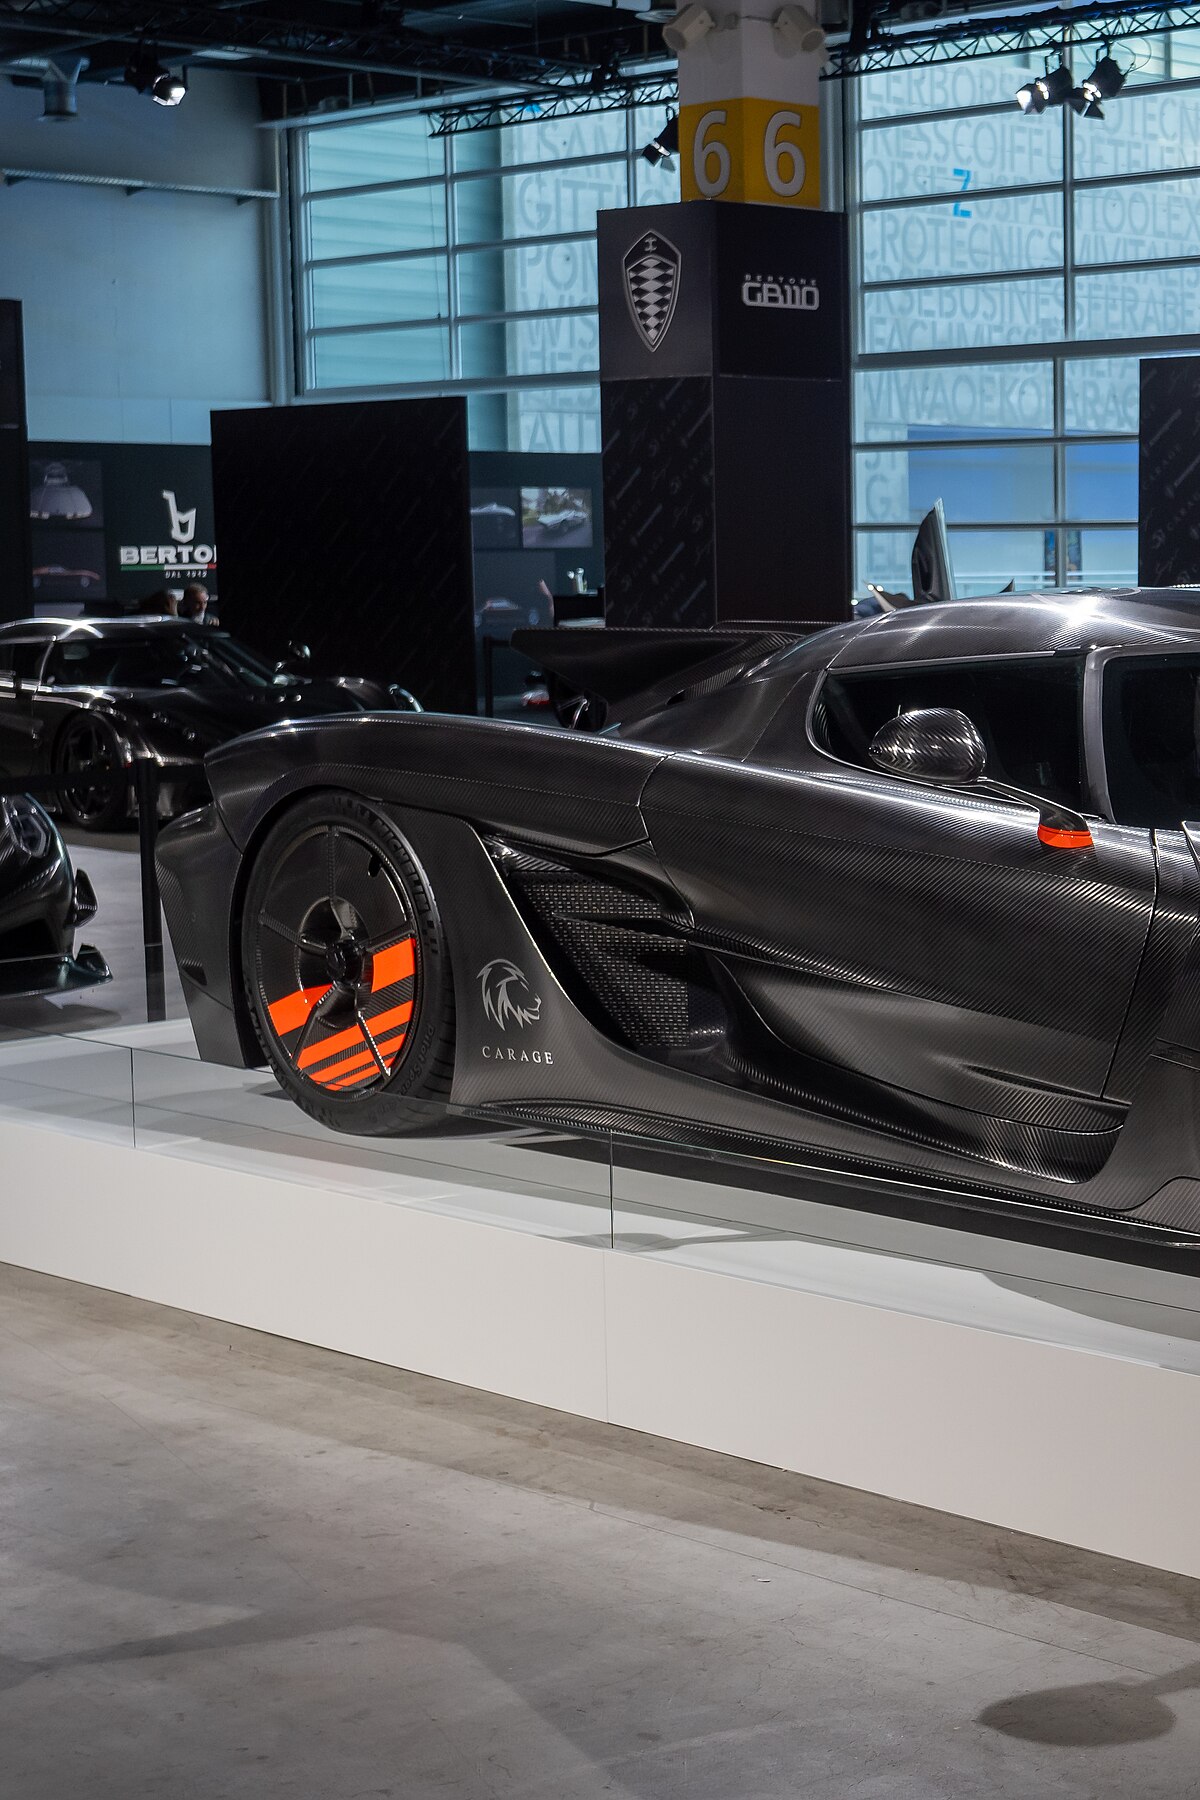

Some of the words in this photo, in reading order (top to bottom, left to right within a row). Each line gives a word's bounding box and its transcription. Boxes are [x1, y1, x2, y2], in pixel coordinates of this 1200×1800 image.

[692, 109, 731, 198] 6
[763, 110, 806, 198] 6
[120, 544, 217, 566] BERTO
[482, 1045, 554, 1065] CARAGE
